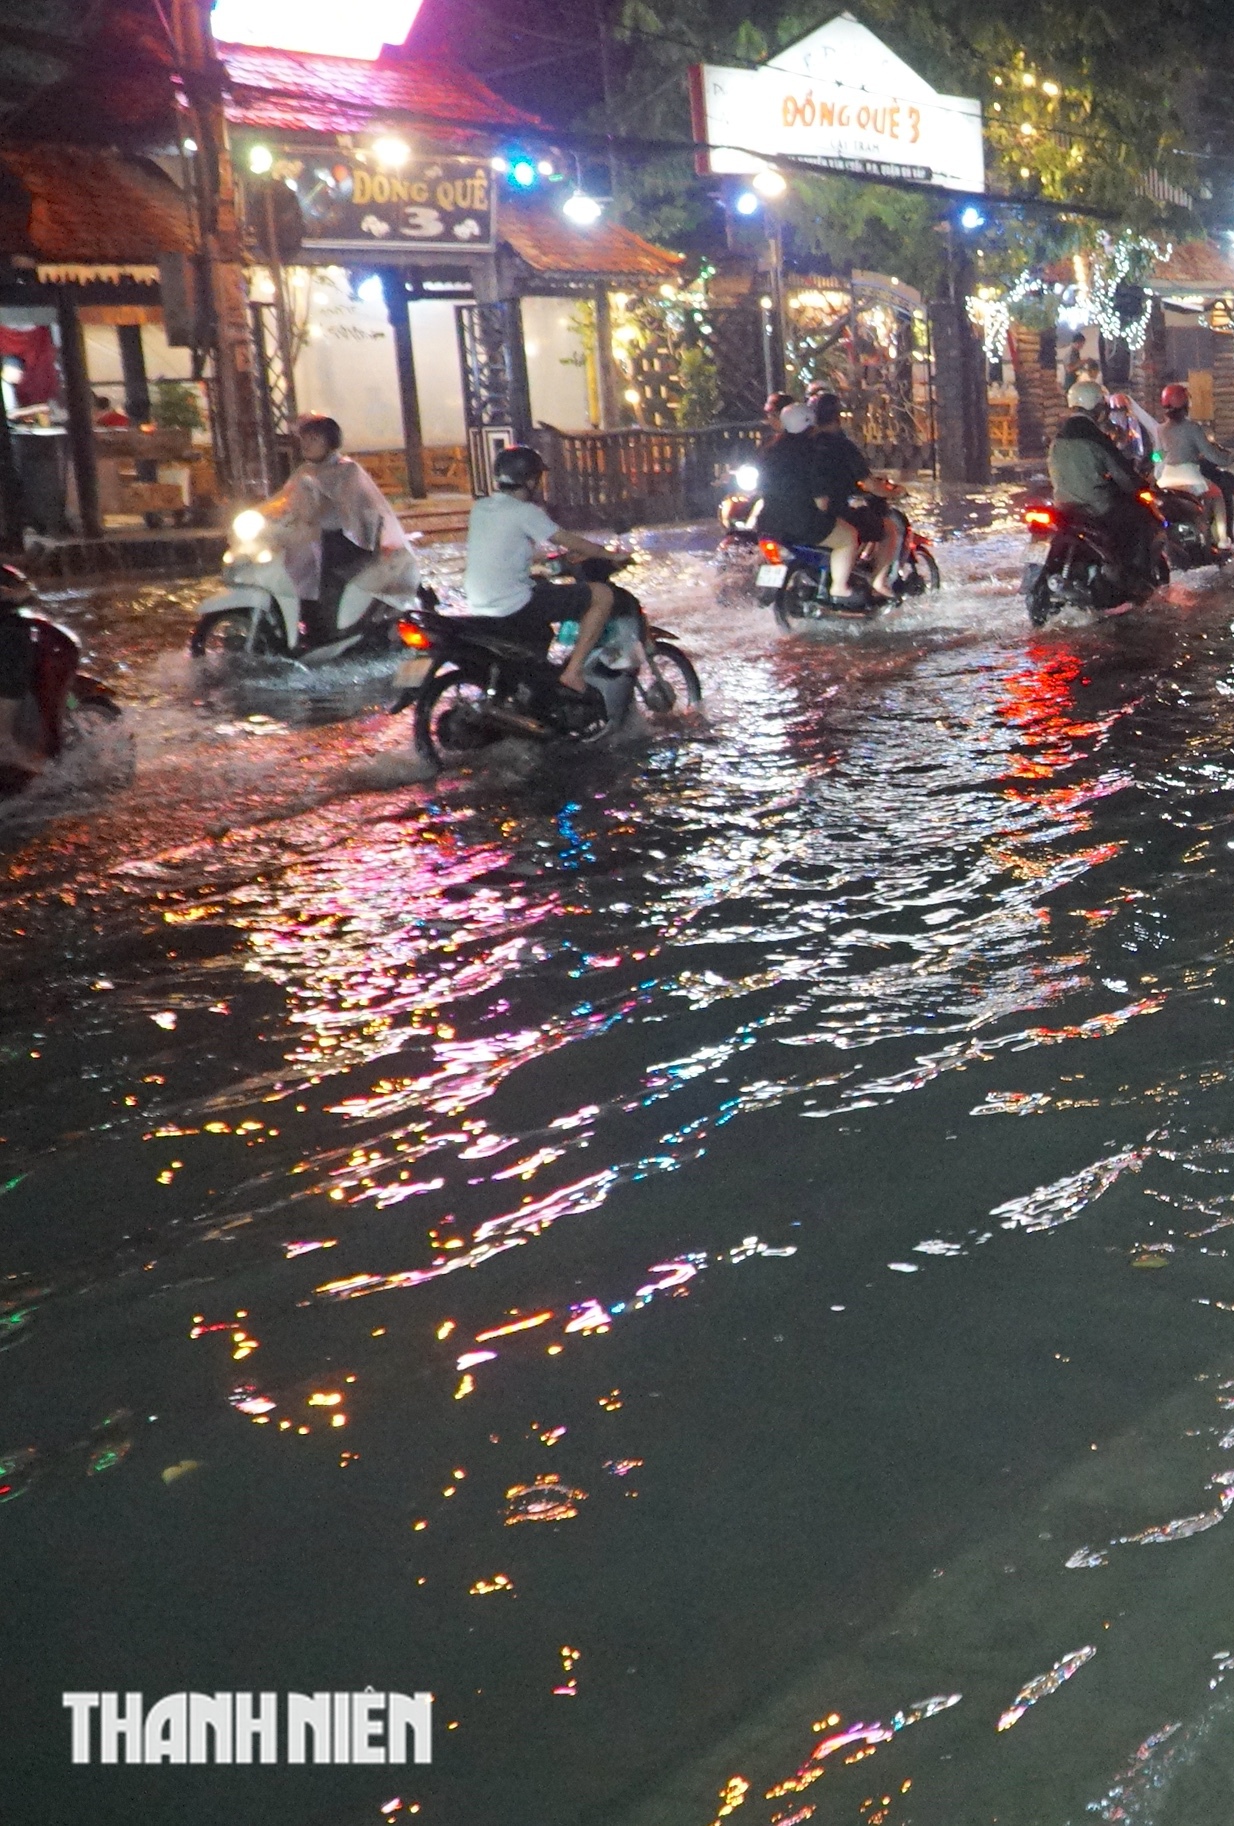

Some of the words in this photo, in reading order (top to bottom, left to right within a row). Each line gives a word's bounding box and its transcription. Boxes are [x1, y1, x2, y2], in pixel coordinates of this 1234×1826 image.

[908, 106, 921, 144] 3
[436, 168, 488, 212] QUÊ
[400, 205, 444, 238] 3
